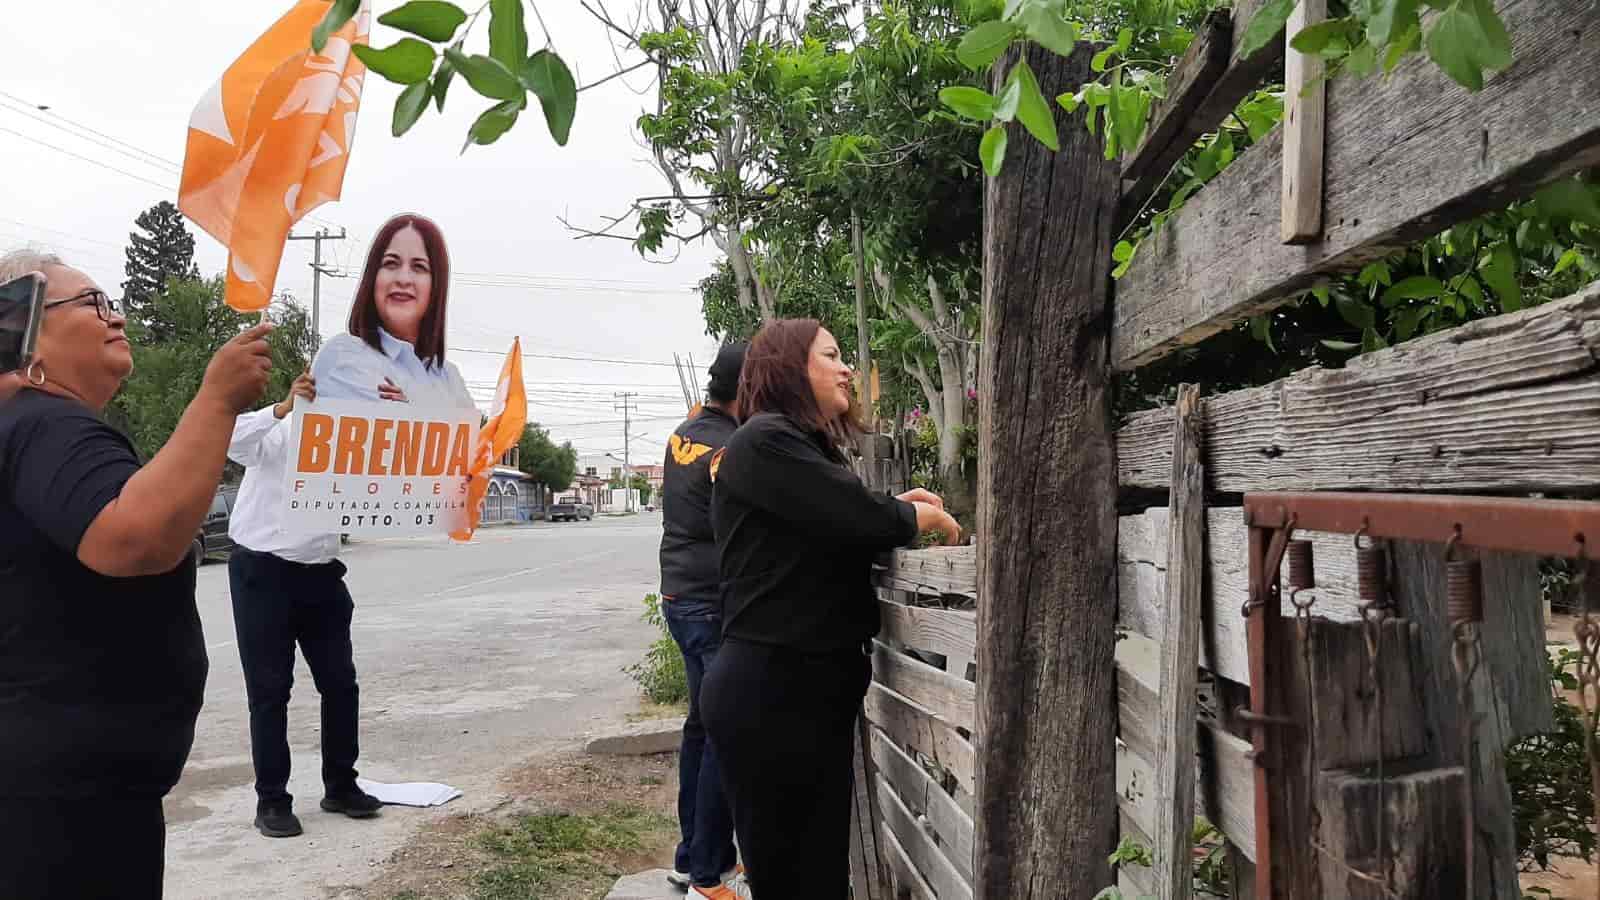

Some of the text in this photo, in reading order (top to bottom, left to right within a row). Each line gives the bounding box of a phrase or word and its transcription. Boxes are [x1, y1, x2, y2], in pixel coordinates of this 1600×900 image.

[297, 413, 471, 477] BRENDA
[294, 480, 466, 495] FLORES
[291, 500, 465, 510] DIPUTADA COAHUILA
[341, 514, 435, 526] DTTO. 03
